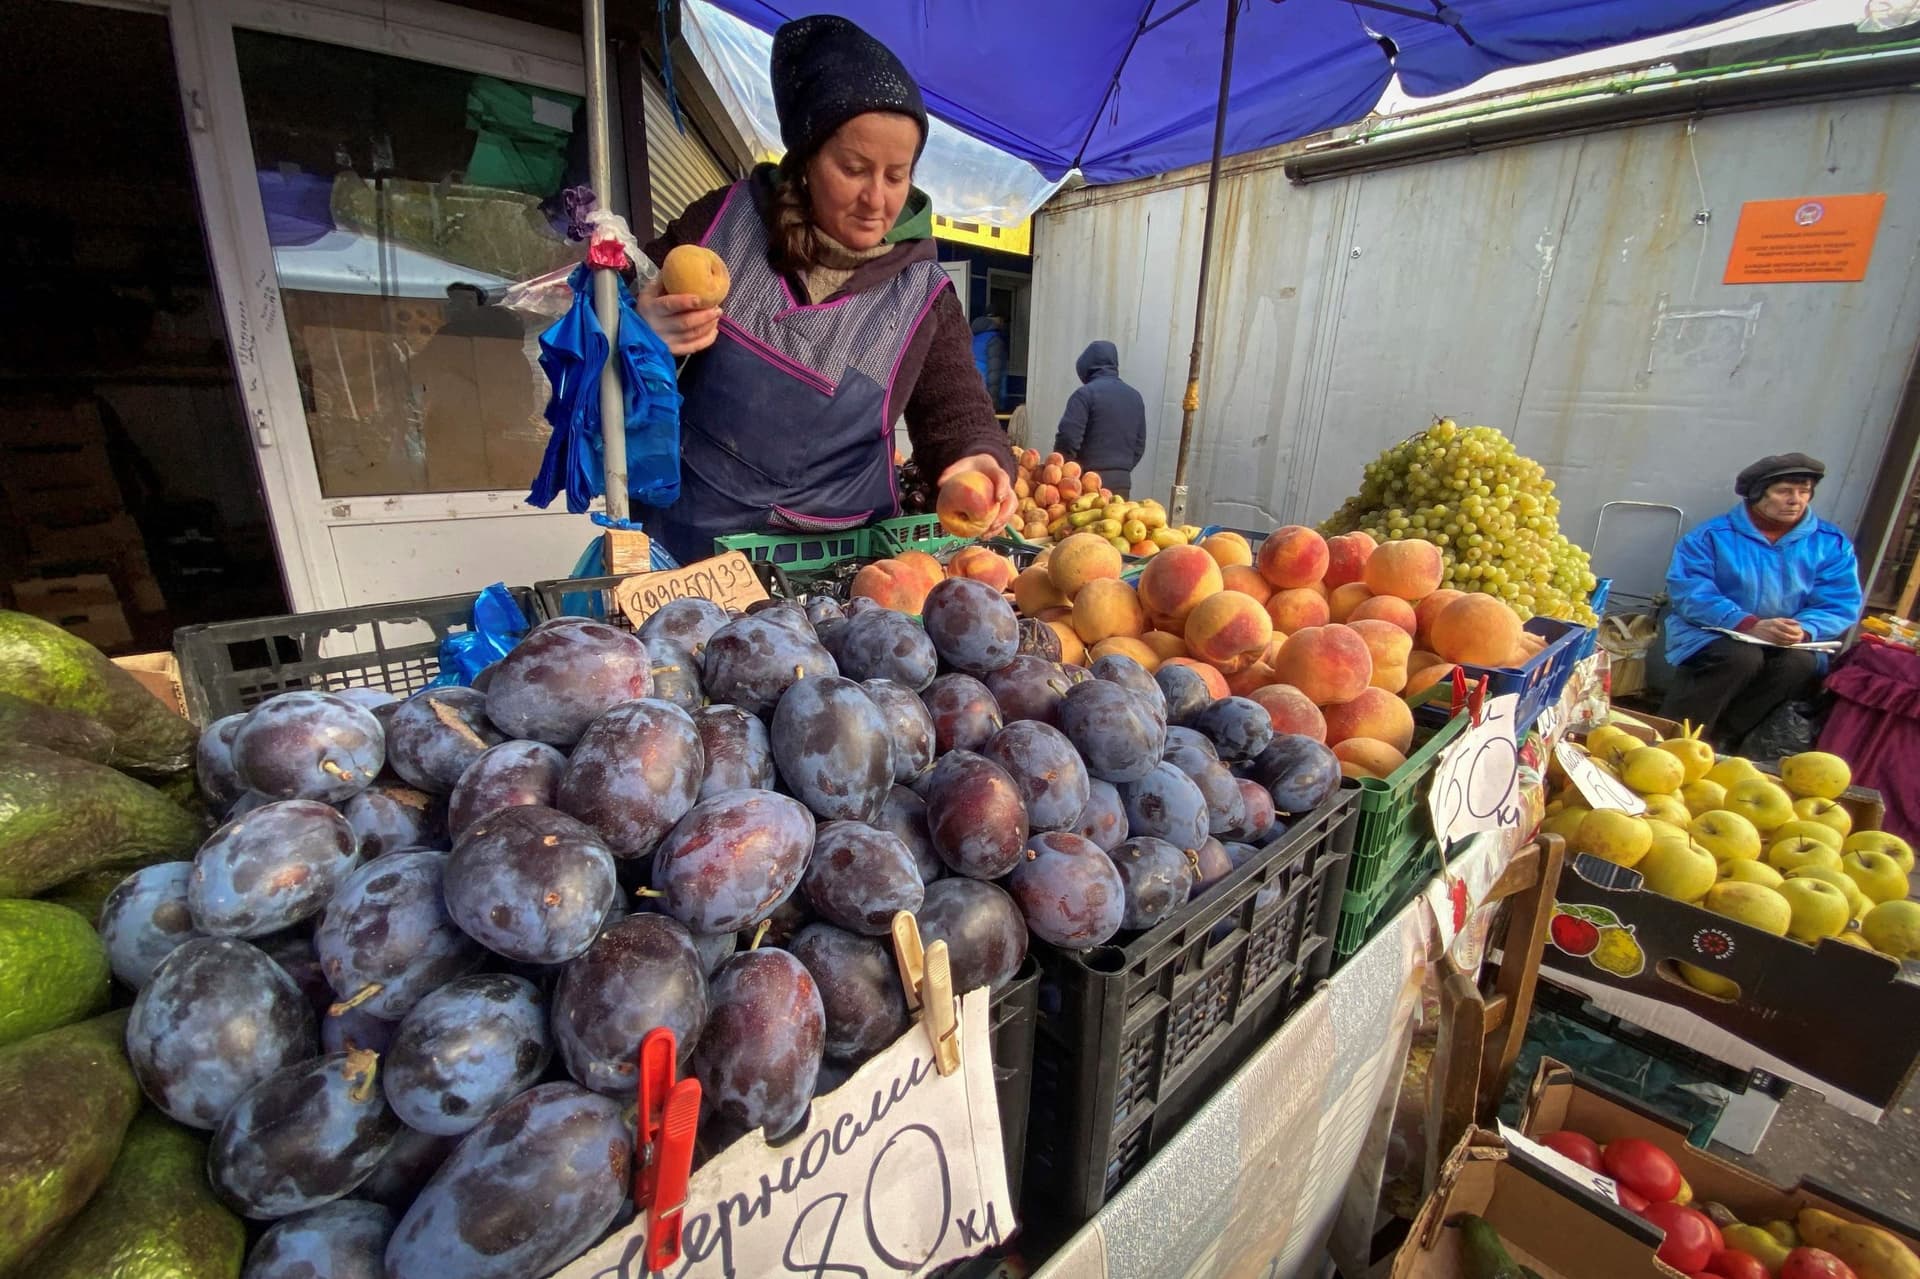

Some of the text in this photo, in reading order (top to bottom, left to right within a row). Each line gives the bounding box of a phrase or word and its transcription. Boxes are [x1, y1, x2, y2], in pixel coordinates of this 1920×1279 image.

[1435, 736, 1518, 842] 150
[589, 1055, 938, 1279] ерносли
[781, 1123, 952, 1279] 80
